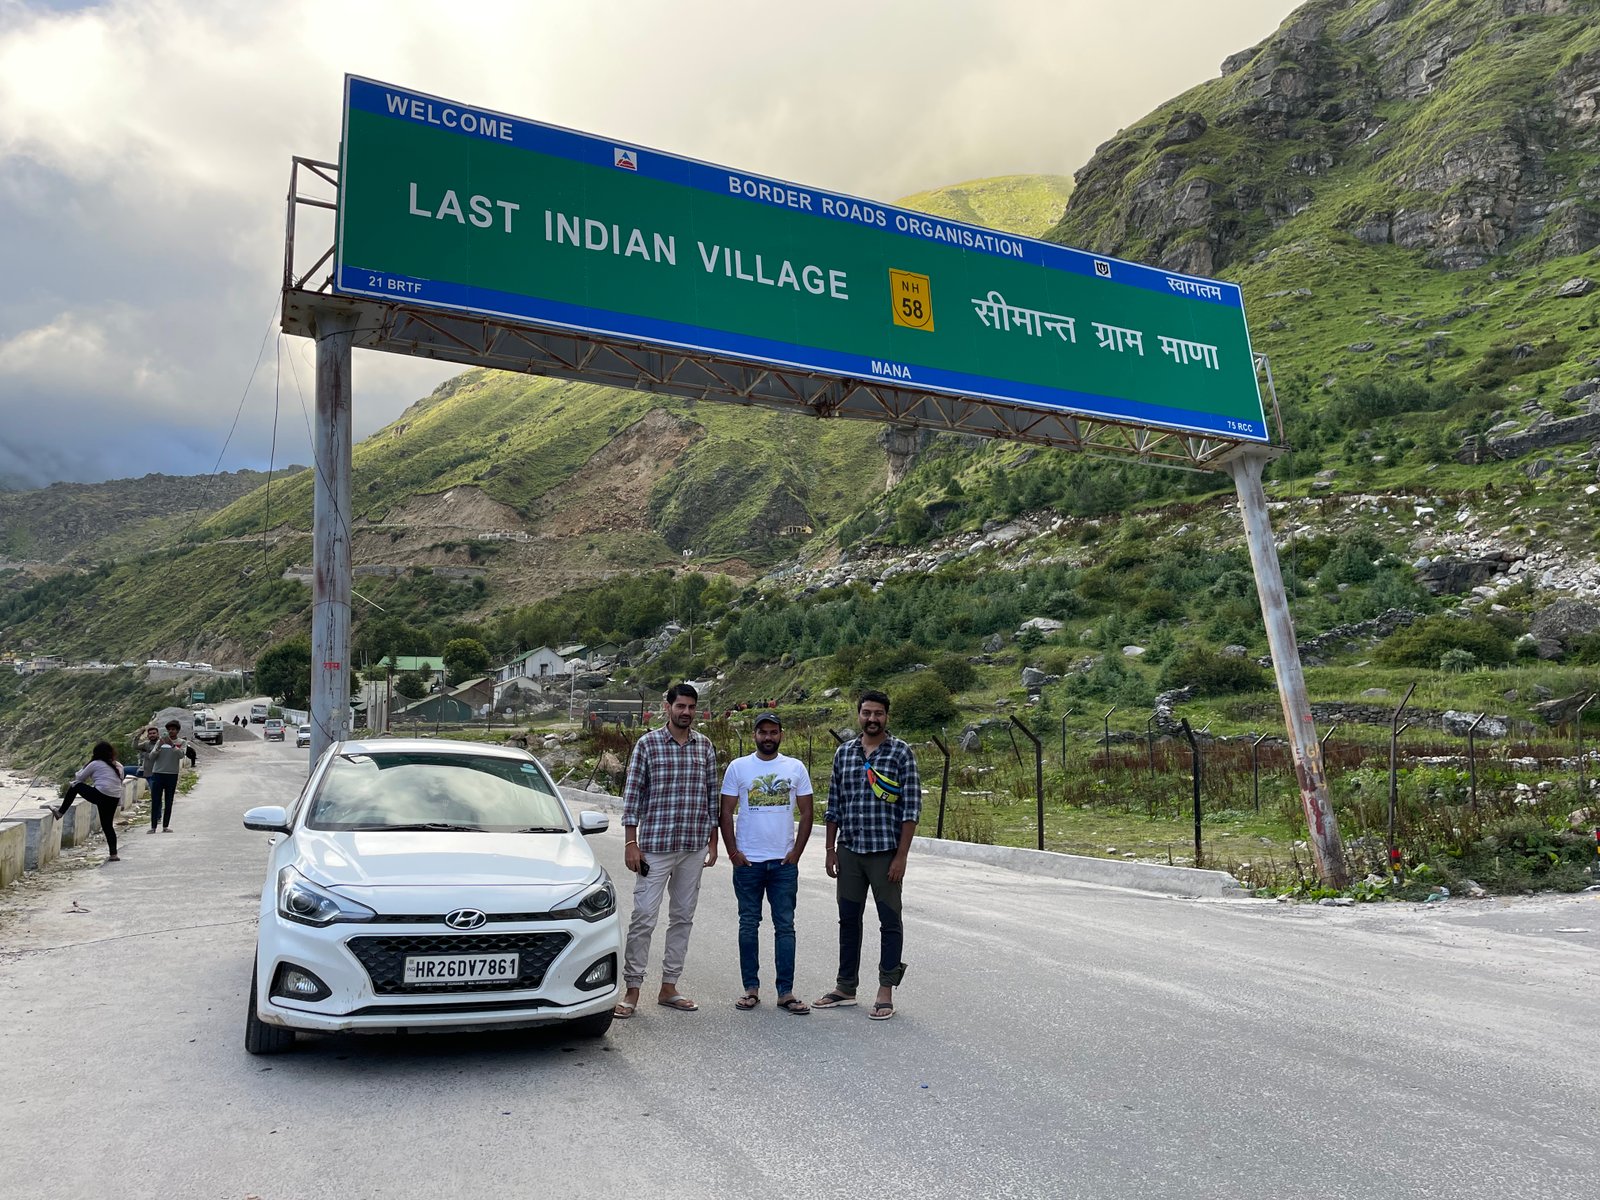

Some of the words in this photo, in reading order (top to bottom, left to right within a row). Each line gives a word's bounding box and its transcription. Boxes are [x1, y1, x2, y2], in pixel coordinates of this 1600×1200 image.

[386, 94, 513, 141] WELCOME
[728, 176, 813, 211] BORDER
[822, 197, 887, 227] ROADS
[895, 215, 1023, 258] ORGANISATION
[409, 182, 520, 233] LAST
[545, 210, 676, 266] INDIAN
[697, 241, 849, 300] VILLAGE
[368, 275, 383, 288] 21
[387, 278, 422, 294] BRTF
[1165, 276, 1221, 300] स्वागतम
[902, 297, 923, 319] 58
[971, 290, 1077, 344] सीमान्त
[1091, 321, 1144, 356] ग्राम
[1157, 335, 1220, 370] माणा
[871, 360, 912, 380] MANA
[1227, 420, 1237, 430] 75
[1237, 422, 1253, 433] RCC
[415, 958, 516, 978] HR26DV7861
